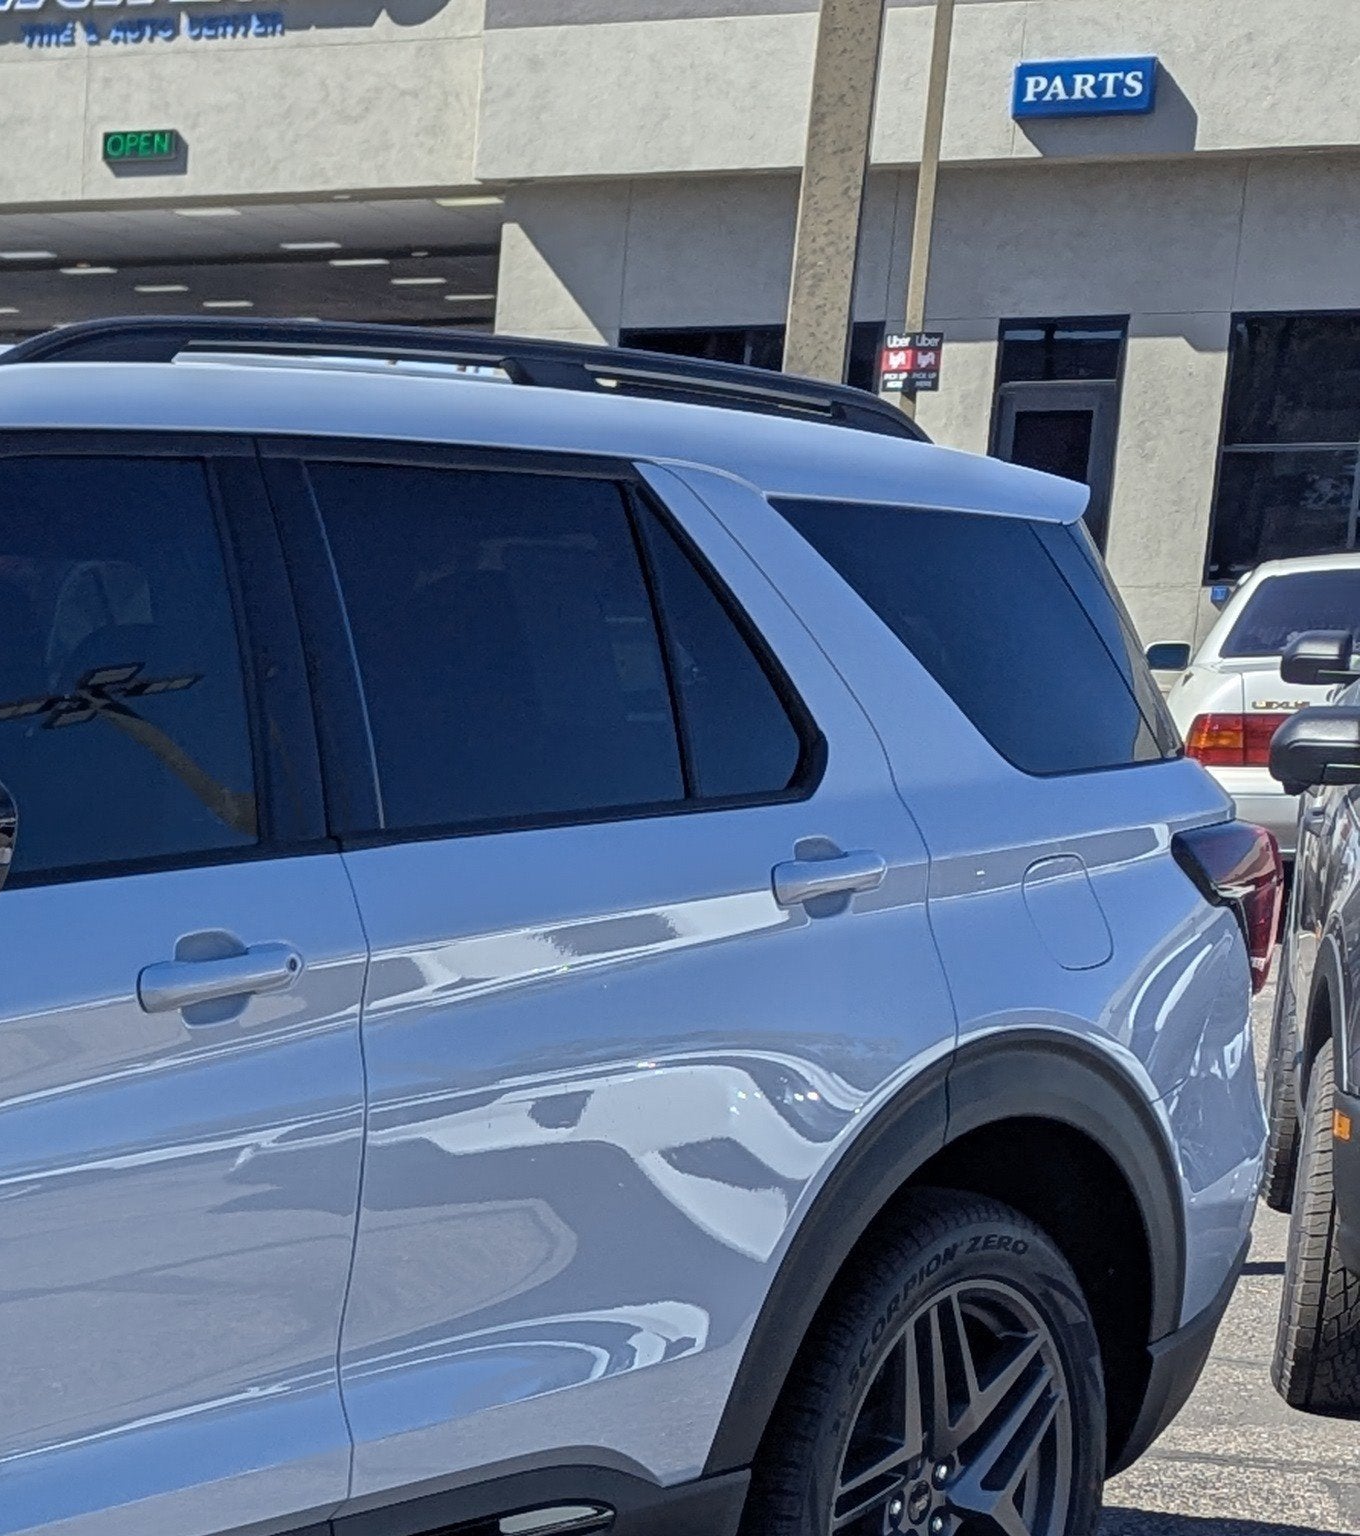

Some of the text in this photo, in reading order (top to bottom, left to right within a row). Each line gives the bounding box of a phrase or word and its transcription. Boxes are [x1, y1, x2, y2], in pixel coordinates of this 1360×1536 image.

[1023, 70, 1145, 103] PARTS
[106, 132, 171, 157] OPEN
[887, 334, 911, 348] Uber
[915, 333, 940, 347] Uber
[966, 1234, 1029, 1257] ZERO
